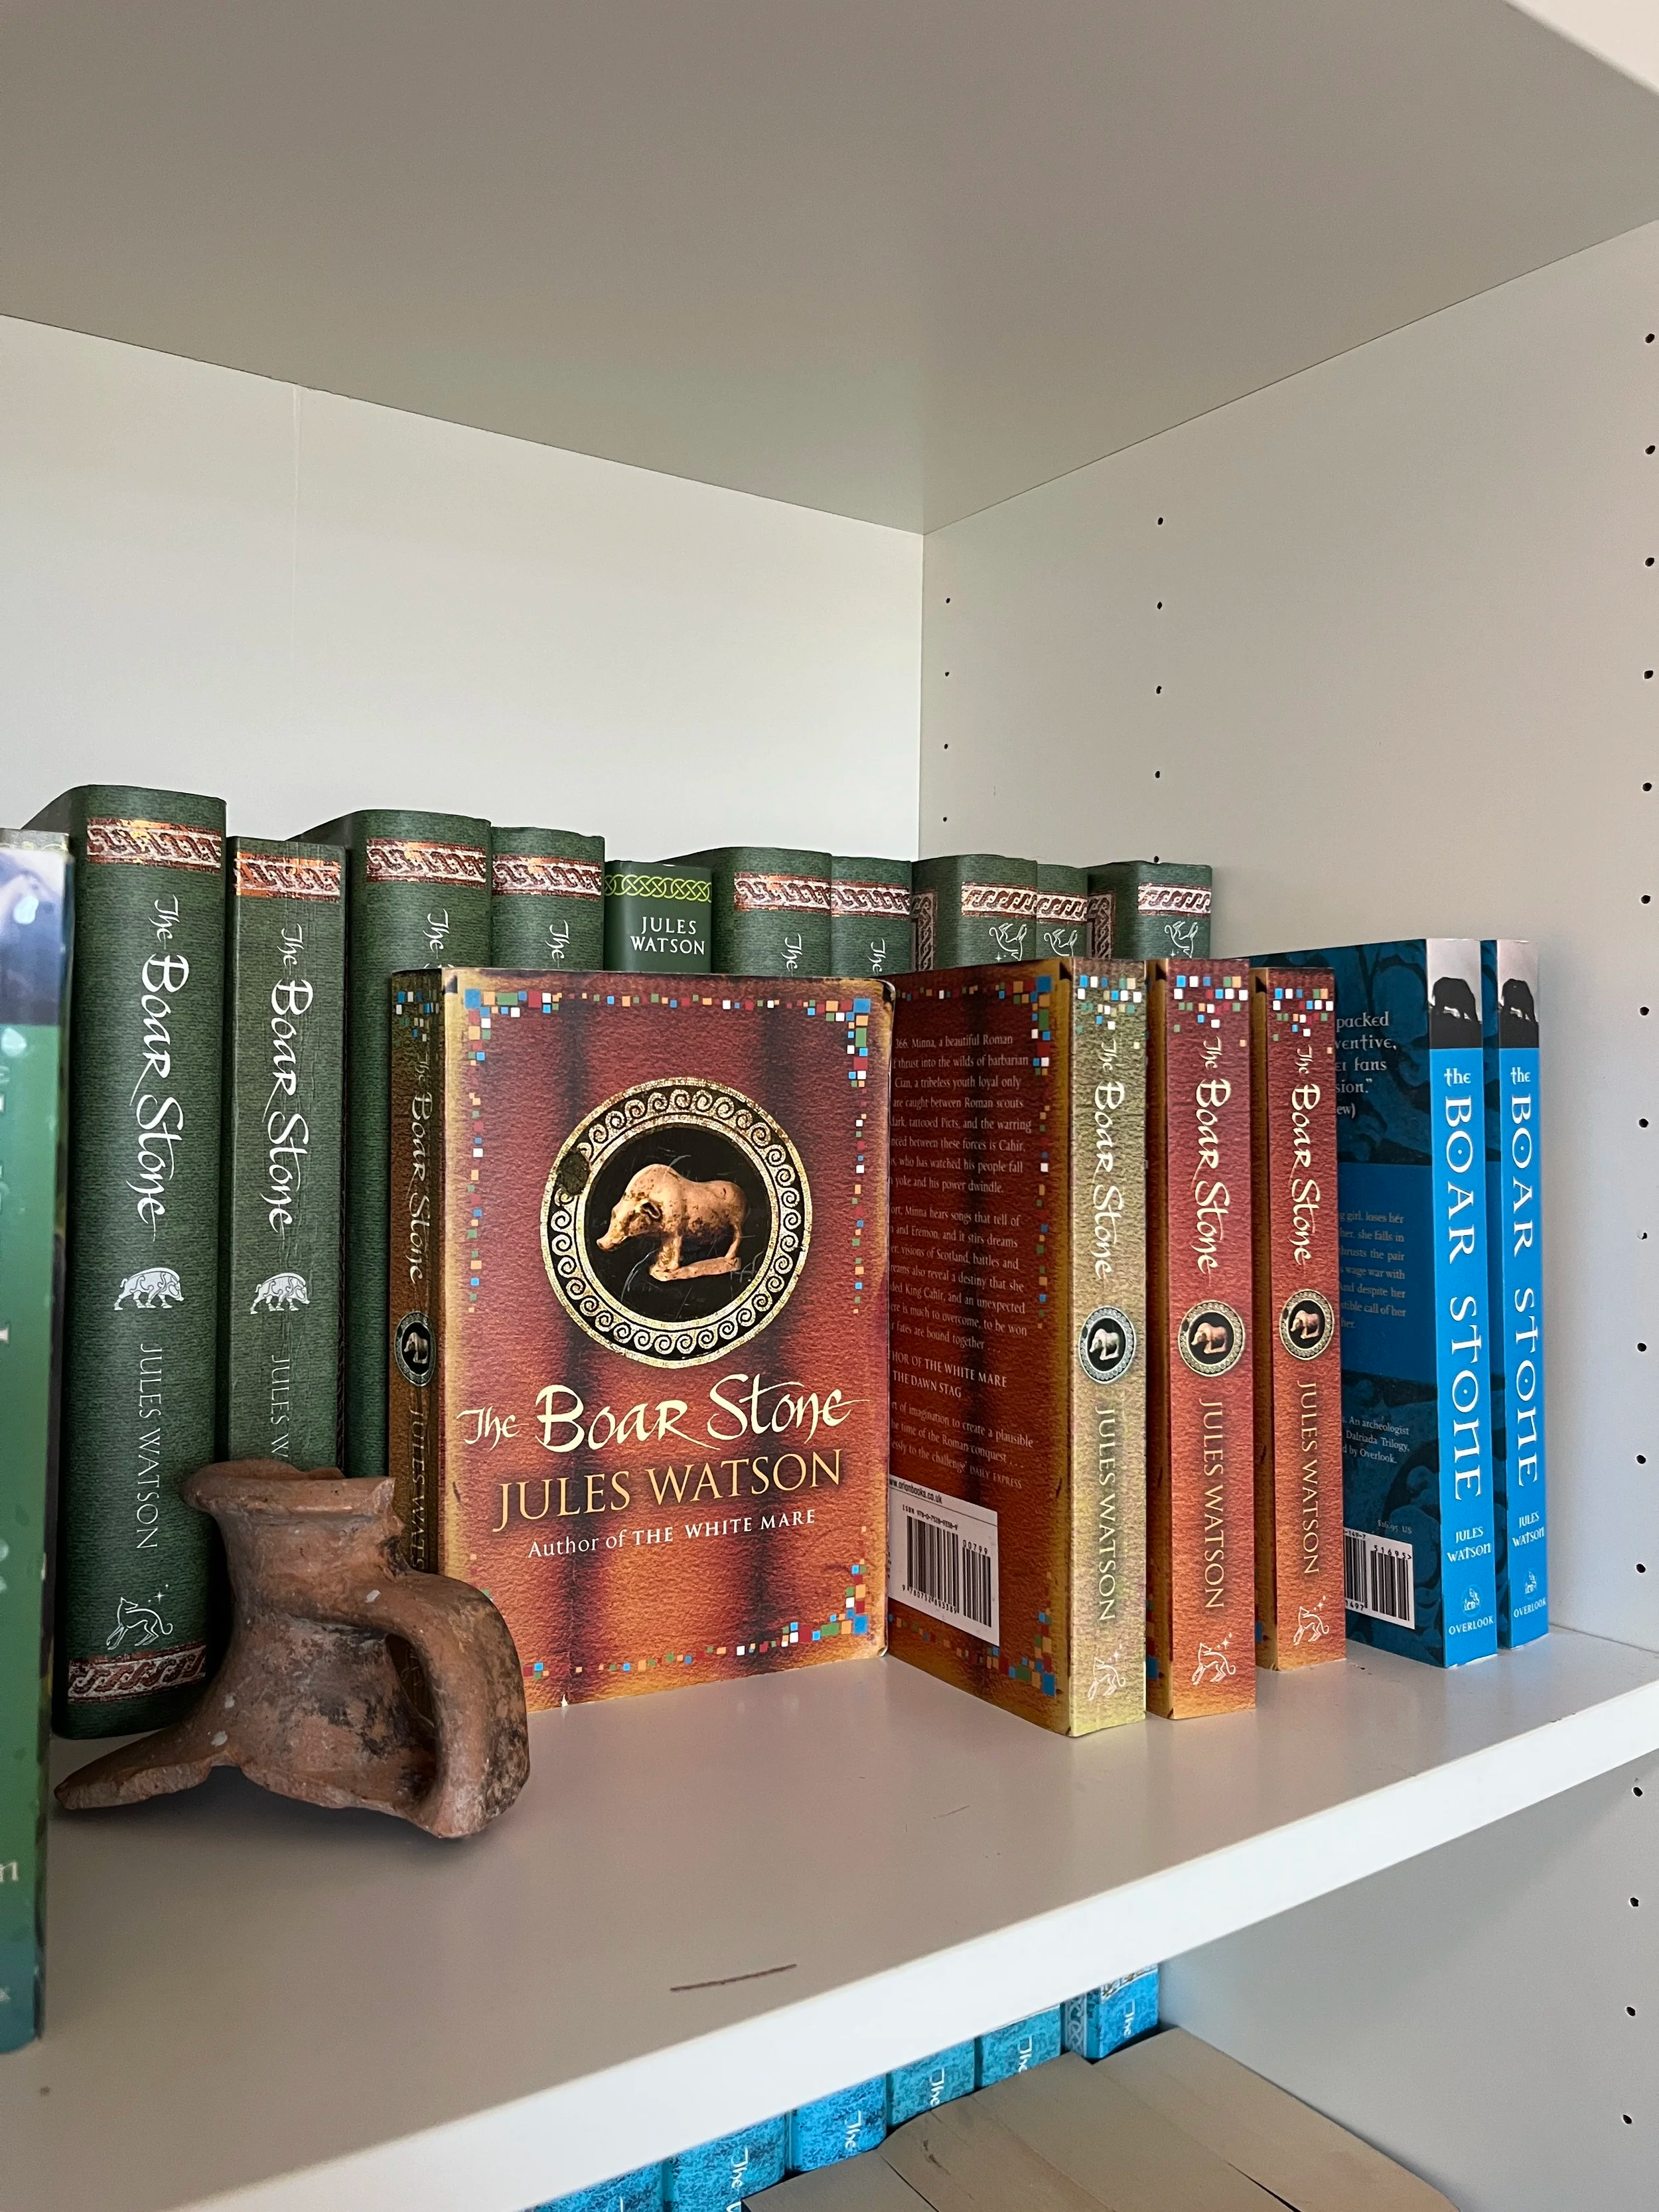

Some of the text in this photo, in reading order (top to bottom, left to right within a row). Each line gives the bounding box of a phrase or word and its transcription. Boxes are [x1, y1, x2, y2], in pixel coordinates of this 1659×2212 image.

[149, 894, 179, 952] The
[422, 908, 450, 960] The
[641, 917, 697, 934] JULES
[277, 924, 304, 975] The
[545, 920, 570, 968] The
[630, 936, 705, 955] WATSON
[781, 933, 802, 976] The
[866, 938, 885, 974] The
[912, 1034, 1013, 1048] Minna, beautiful Roman
[1098, 1038, 1117, 1072] The
[1200, 1036, 1222, 1069] The
[899, 1054, 1028, 1069] thrust into the wilds barbarian
[1295, 1045, 1313, 1076] The
[1354, 1058, 1386, 1072] fans
[953, 1075, 1021, 1090] youth loyal only
[905, 1096, 1023, 1110] caught between Roman scouts
[909, 1117, 1031, 1134] tattooed and the warring
[910, 1137, 938, 1147] between
[941, 1138, 960, 1149] these
[963, 1137, 986, 1149] forces
[125, 1093, 183, 1242] Stone
[899, 1156, 1023, 1174] who has watched his people fall
[1444, 1068, 1475, 1264] the BOAR
[1510, 1067, 1534, 1258] the BOAR
[261, 1111, 309, 1248] Stone
[896, 1175, 1003, 1193] yoke and his power dwindle.
[905, 1206, 926, 1218] Minna
[930, 1206, 948, 1219] hears
[951, 1212, 972, 1224] songs
[975, 1211, 990, 1224] that
[993, 1214, 1007, 1226] tell
[1011, 1215, 1021, 1226] of
[1090, 1183, 1125, 1282] Stone
[1289, 1178, 1321, 1276] Stone
[405, 1193, 430, 1284] Stone
[897, 1226, 1017, 1248] and and stirs dreams
[1191, 1179, 1230, 1287] Stone
[901, 1244, 1018, 1270] visions battles and
[1388, 1250, 1405, 1262] pair
[912, 1266, 925, 1277] also
[928, 1270, 948, 1282] reveal
[958, 1271, 987, 1290] destiny
[989, 1277, 1005, 1290] that
[1009, 1279, 1024, 1293] she
[906, 1283, 922, 1299] King
[948, 1293, 962, 1303] and
[964, 1297, 974, 1306] an
[977, 1297, 1025, 1314] unexpected
[910, 1306, 1027, 1337] much to overcome, to be won
[914, 1326, 984, 1350] are bound together
[893, 1370, 962, 1398] THE DAWN STAG
[912, 1356, 922, 1367] OF
[924, 1359, 942, 1372] THE
[944, 1363, 975, 1380] WHITE
[978, 1372, 1007, 1388] MARE
[1514, 1288, 1538, 1487] STONE
[271, 1355, 290, 1424] JULES
[1449, 1295, 1482, 1501] STONE
[455, 1405, 529, 1451] The
[707, 1374, 870, 1443] Stone
[909, 1406, 1033, 1448] imagination to create plausible
[1349, 1416, 1409, 1436] An archeologist
[136, 1344, 163, 1548] JULES WATSON
[928, 1430, 1007, 1463] the conquest
[1346, 1430, 1409, 1452] Dalriada Trilogy.
[1350, 1445, 1357, 1457] by
[918, 1447, 929, 1459] the
[970, 1465, 990, 1479] DAILY
[993, 1473, 1022, 1489] EXPRESS
[1297, 1380, 1319, 1574] JULES WATSON
[409, 1406, 425, 1569] JULES WATS
[492, 1449, 842, 1532] JULES WATSON
[1199, 1399, 1224, 1609] JULES WATSON
[1095, 1406, 1116, 1620] JULES WATSON
[1519, 1511, 1540, 1528] JULES
[528, 1510, 816, 1558] Author of THE WHITE MARE
[1455, 1526, 1484, 1544] JULES
[1512, 1526, 1545, 1547] WATSON
[1447, 1543, 1491, 1562] WATSON
[1514, 1597, 1546, 1618] OVERLOOK
[1449, 1615, 1493, 1635] OVERLOOK
[1123, 1998, 1135, 2037] The
[929, 2067, 945, 2106] The
[845, 2110, 861, 2148] The
[732, 2148, 747, 2190] The
